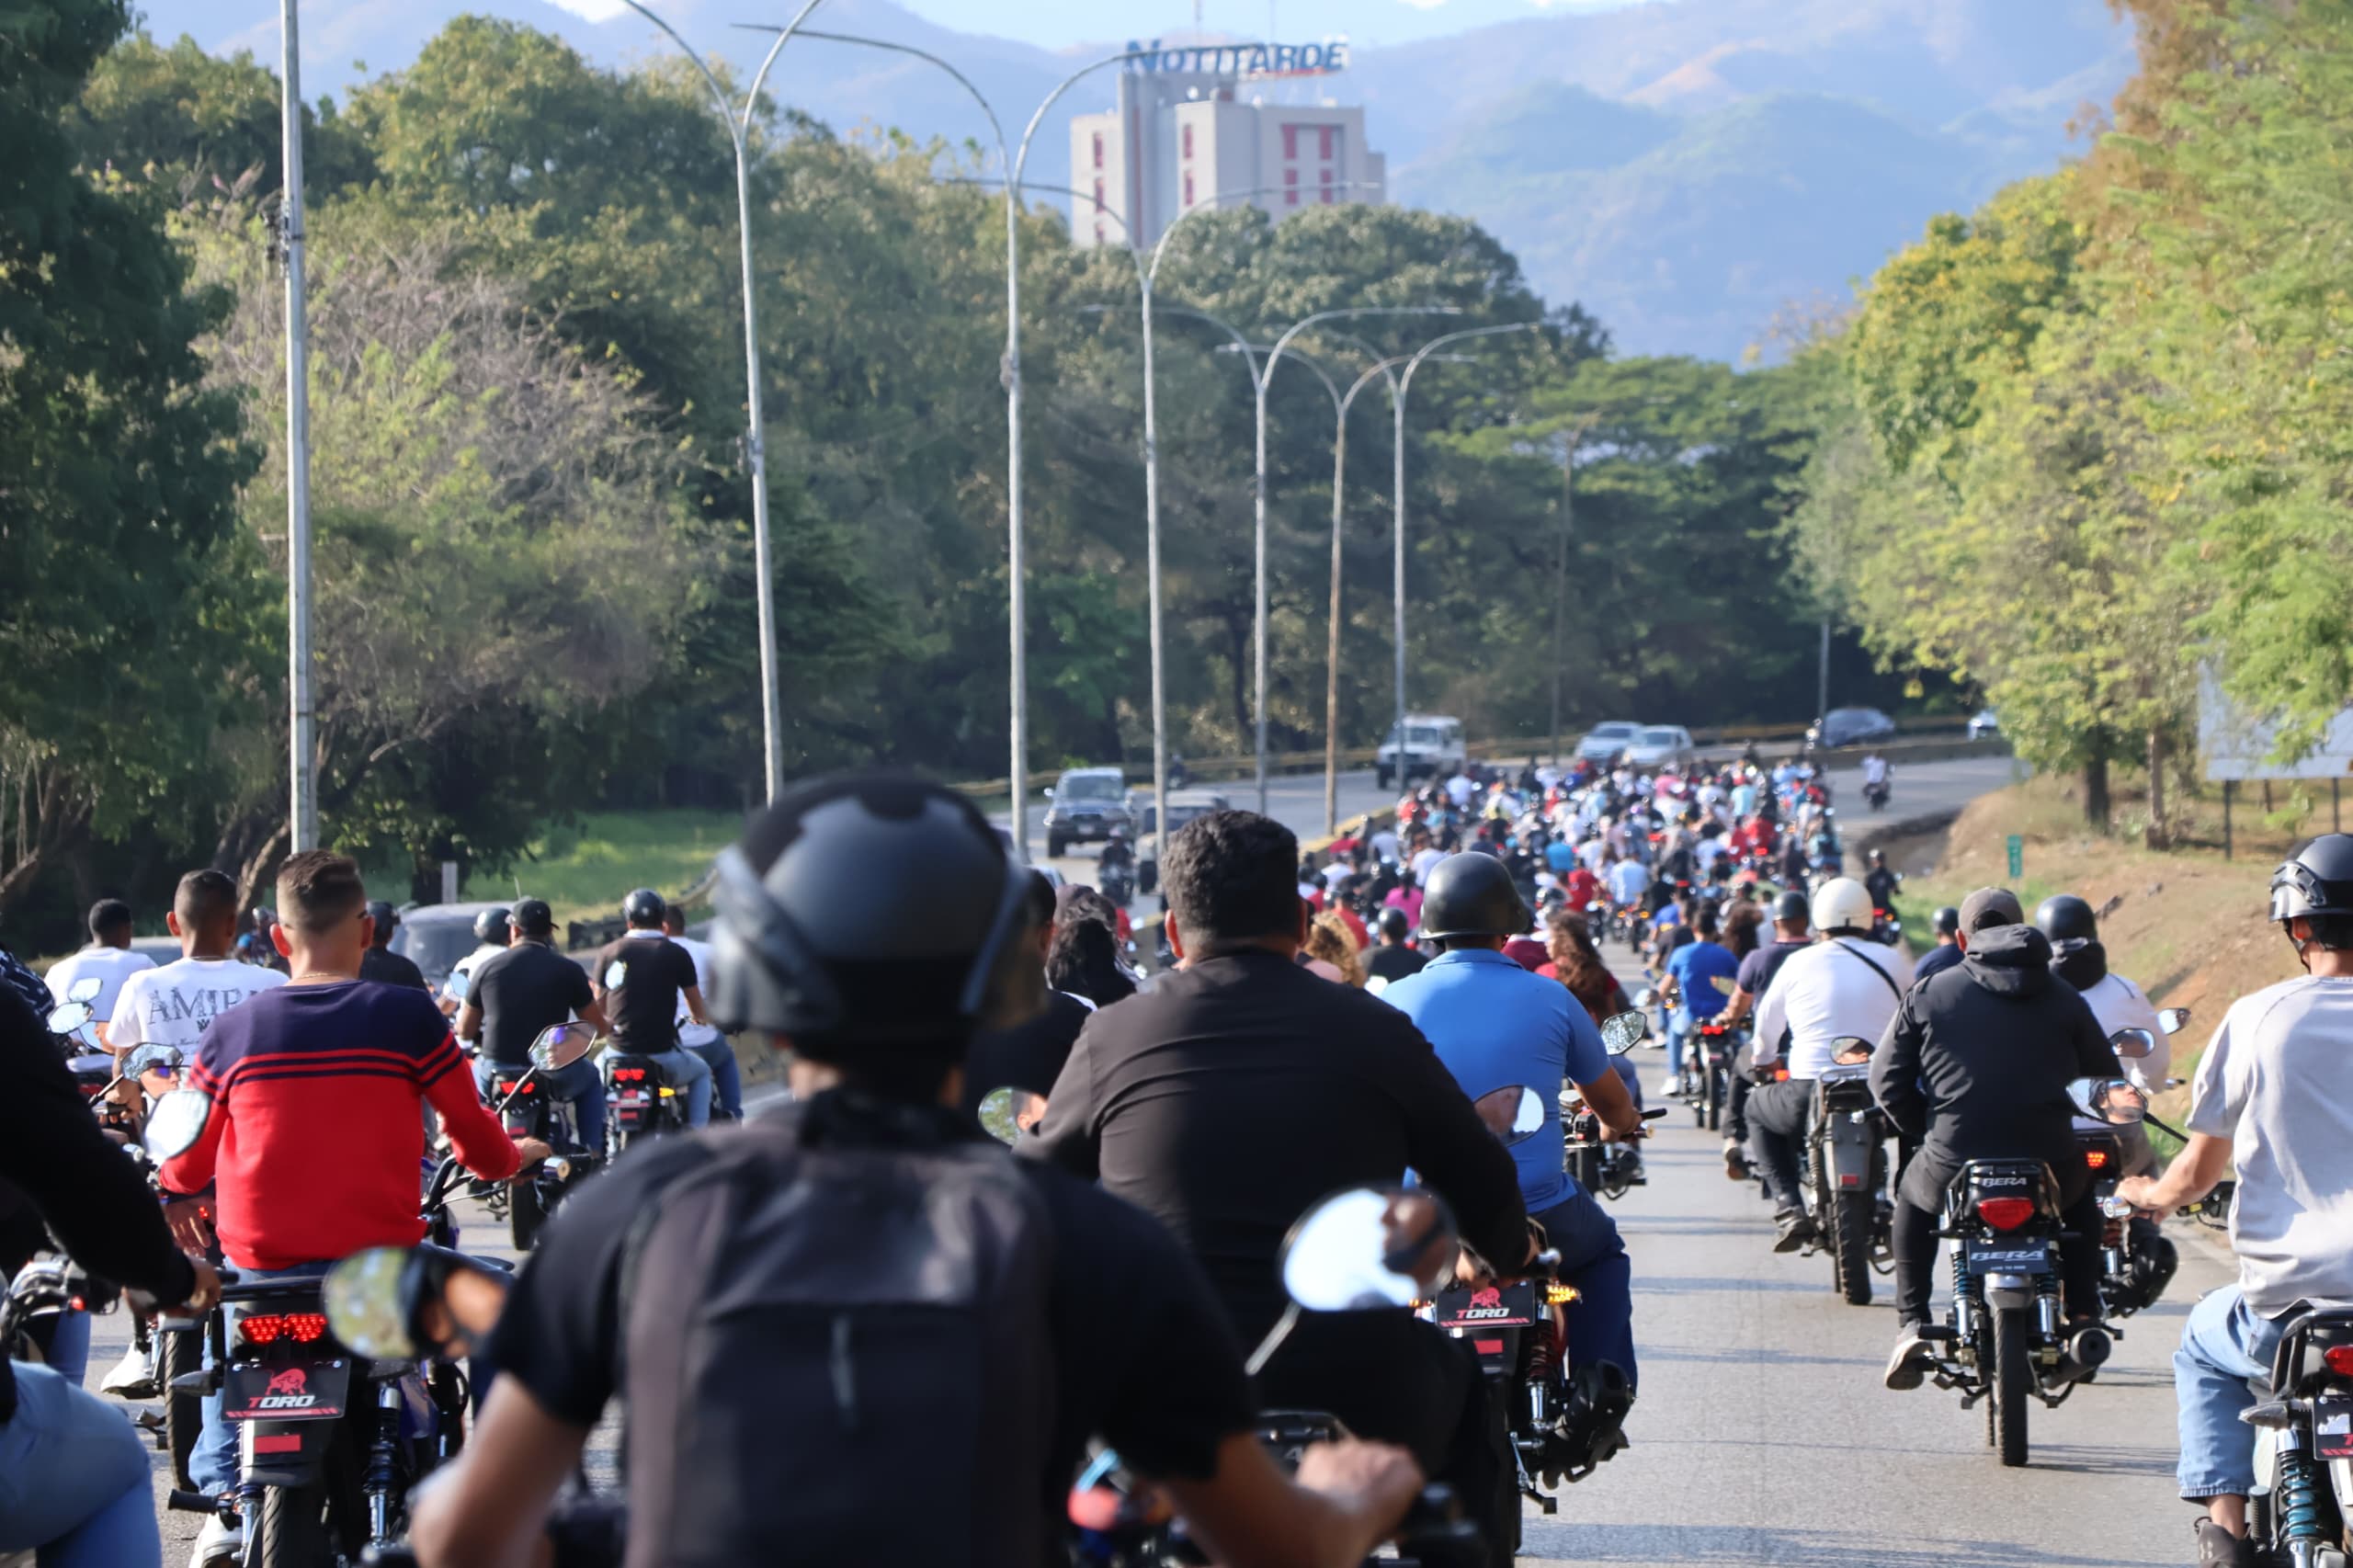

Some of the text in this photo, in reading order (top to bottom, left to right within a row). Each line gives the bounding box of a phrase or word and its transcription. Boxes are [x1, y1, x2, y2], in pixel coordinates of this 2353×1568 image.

[1124, 40, 1348, 74] NOTITARDE
[147, 986, 258, 1025] AMIR
[1982, 1176, 2028, 1187] BERA
[1970, 1249, 2045, 1262] BERA
[1456, 1307, 1510, 1319] TORO
[248, 1395, 315, 1409] TORO
